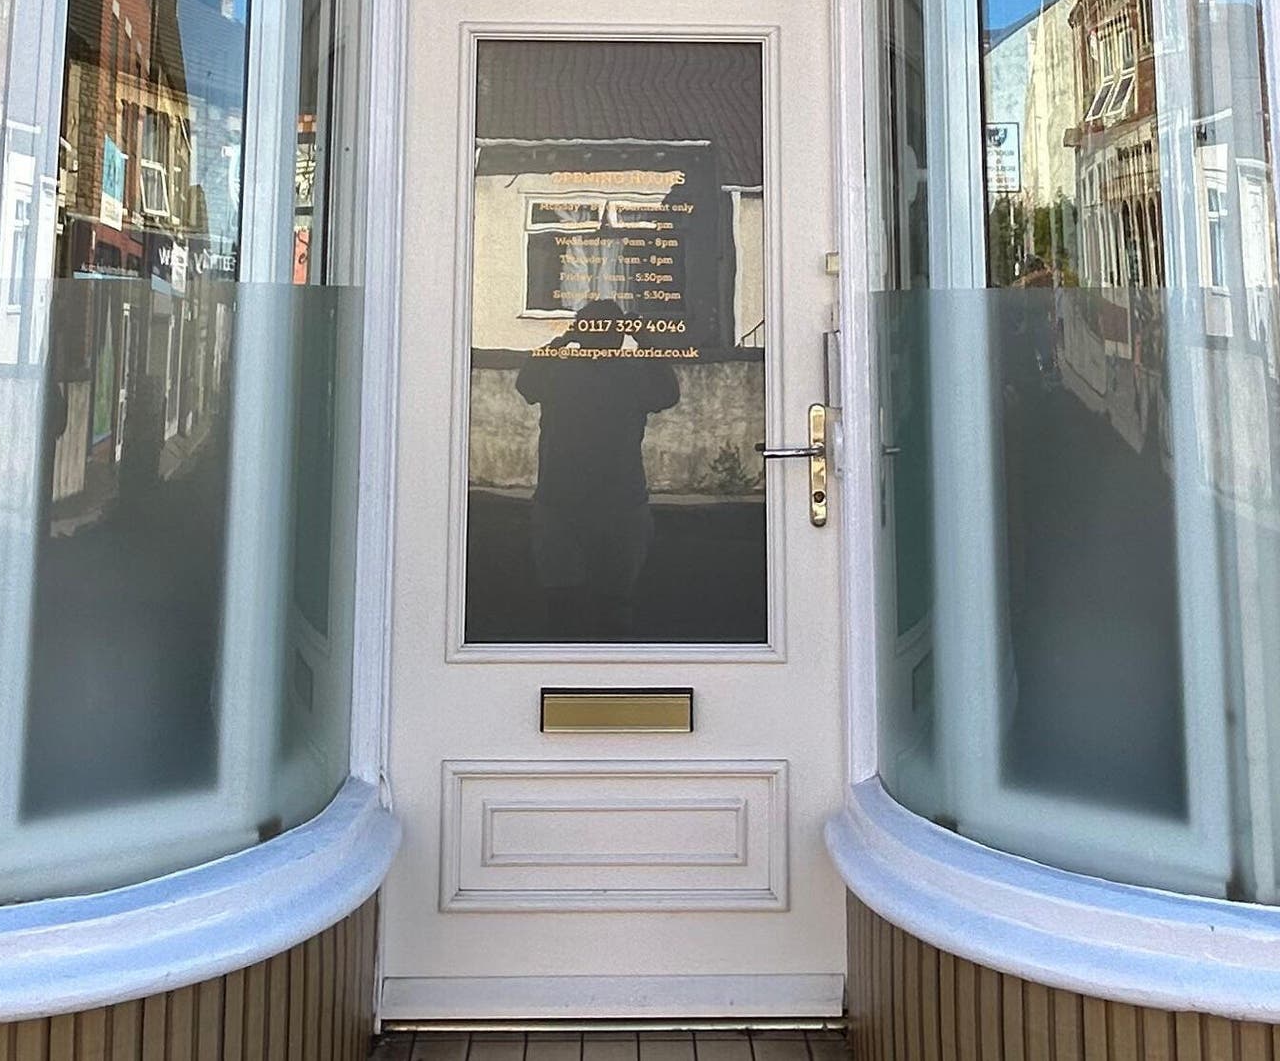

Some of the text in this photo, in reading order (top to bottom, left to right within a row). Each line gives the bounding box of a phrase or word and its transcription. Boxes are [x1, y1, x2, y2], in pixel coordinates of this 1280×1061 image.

[671, 202, 694, 214] only
[655, 237, 679, 248] 8pm
[650, 255, 673, 266] 8pm
[577, 320, 612, 332] 0117
[616, 320, 643, 332] 329
[646, 320, 686, 333] 4046
[532, 346, 700, 360] info@harpervictoria.co.uk
